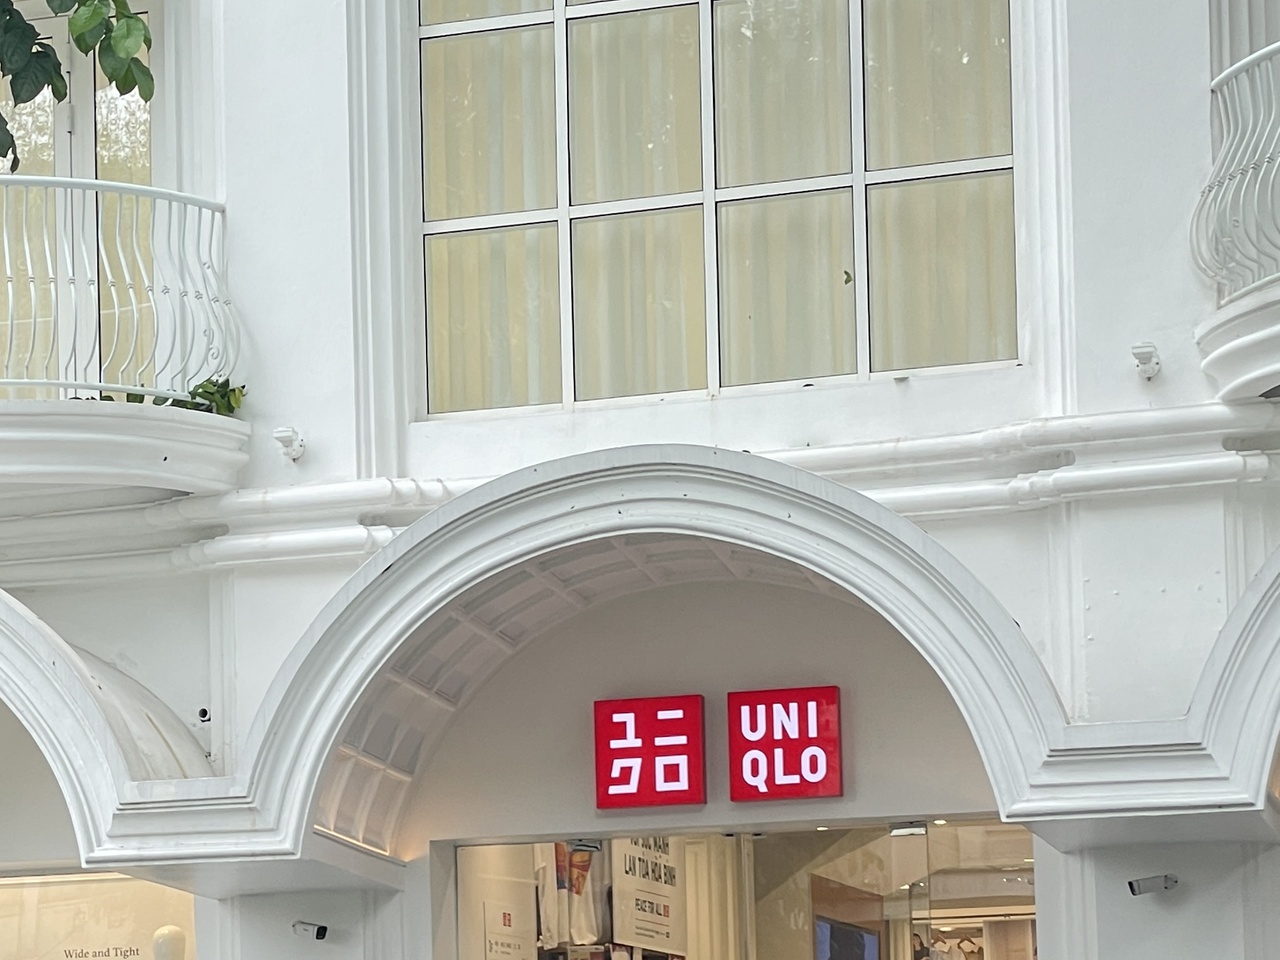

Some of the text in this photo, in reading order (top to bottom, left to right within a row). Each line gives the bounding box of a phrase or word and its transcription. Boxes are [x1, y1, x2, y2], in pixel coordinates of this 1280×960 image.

[609, 709, 689, 750] ユニ
[740, 700, 818, 742] UNI
[607, 754, 690, 795] クロ
[741, 745, 828, 793] QLO
[63, 946, 140, 960] Wide and Tight
